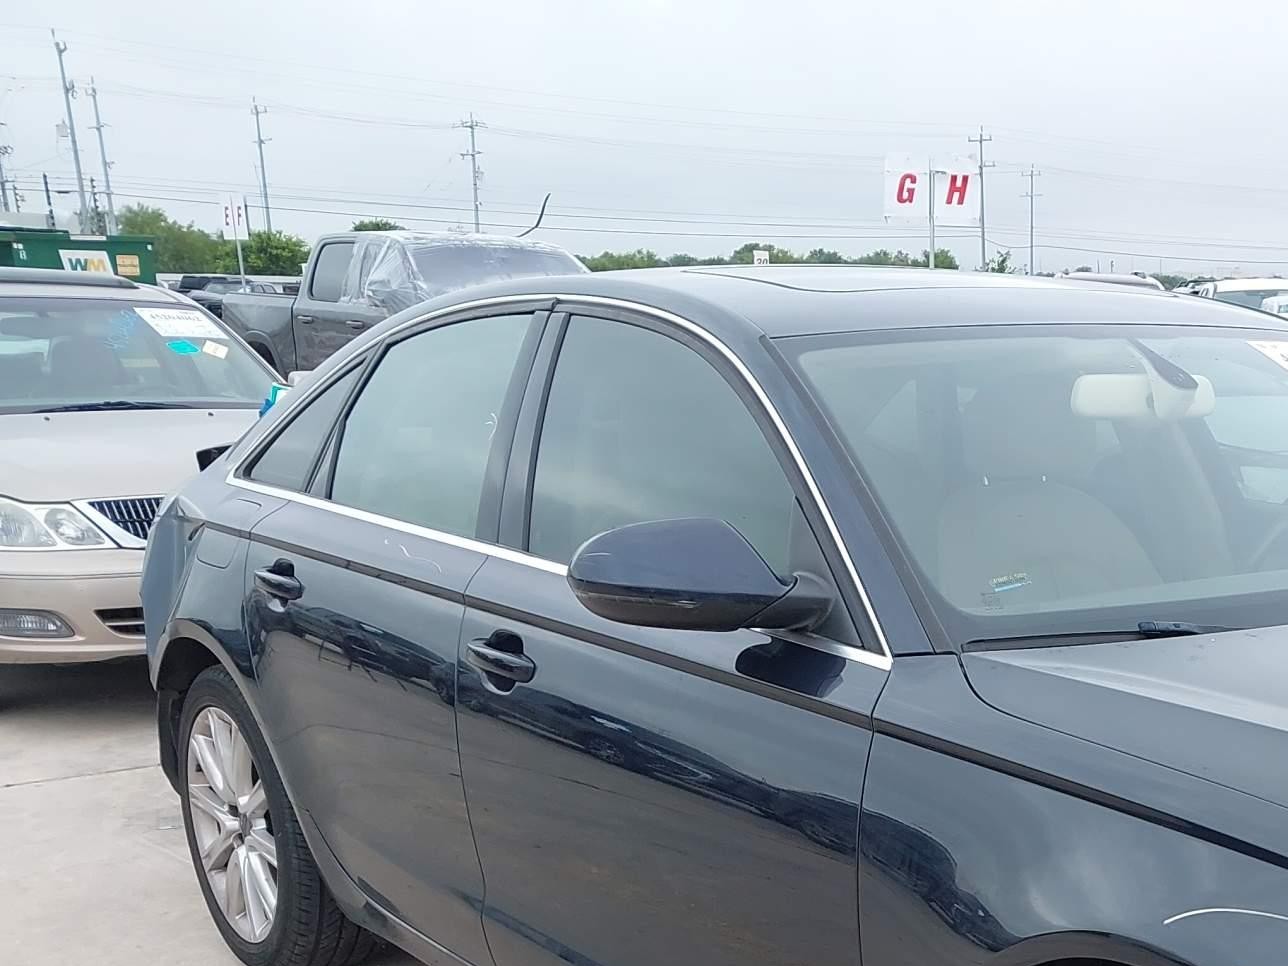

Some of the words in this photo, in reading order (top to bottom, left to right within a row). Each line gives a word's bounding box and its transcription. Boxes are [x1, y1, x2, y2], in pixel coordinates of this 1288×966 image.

[896, 173, 917, 204] G
[945, 174, 969, 205] H
[224, 206, 229, 226] E
[237, 206, 242, 226] F
[68, 257, 107, 272] WM
